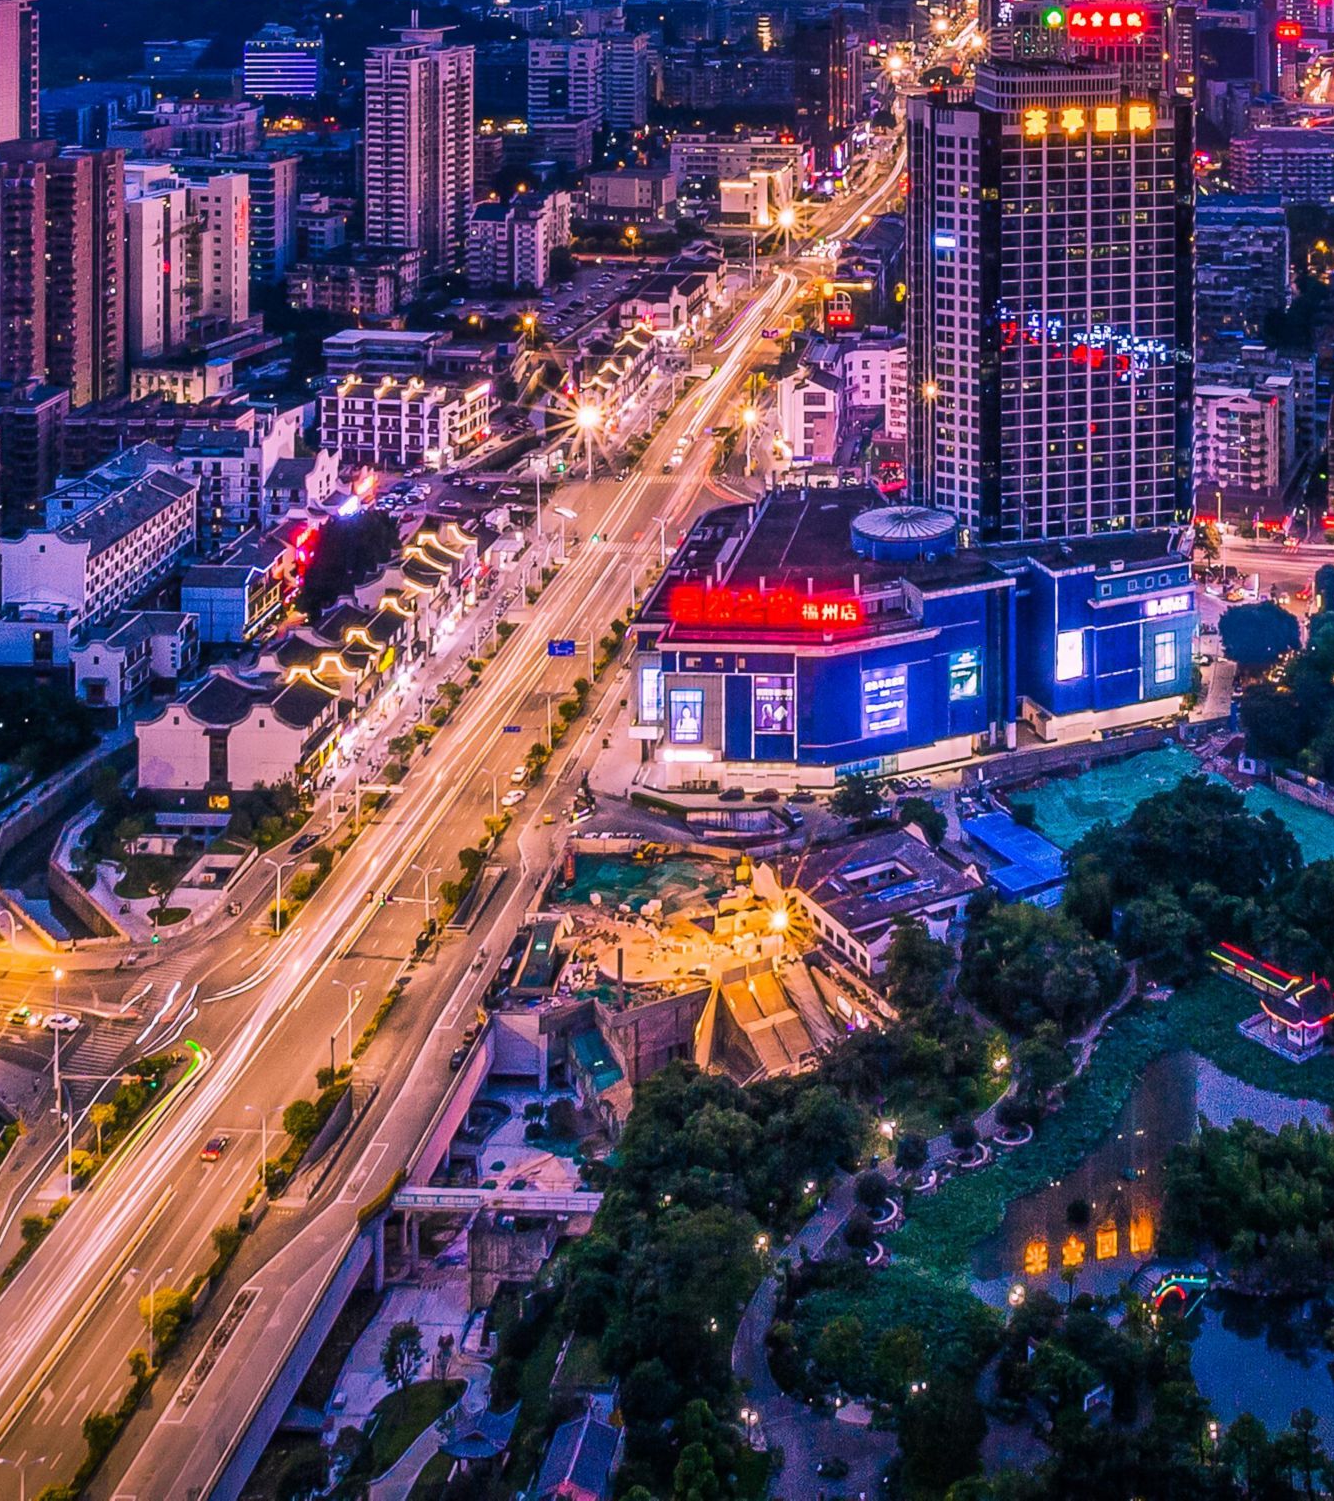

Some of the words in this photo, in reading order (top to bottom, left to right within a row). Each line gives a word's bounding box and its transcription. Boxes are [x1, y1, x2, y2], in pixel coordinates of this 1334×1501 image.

[1024, 106, 1154, 136] 茶亭国际
[802, 603, 857, 622] 福州店
